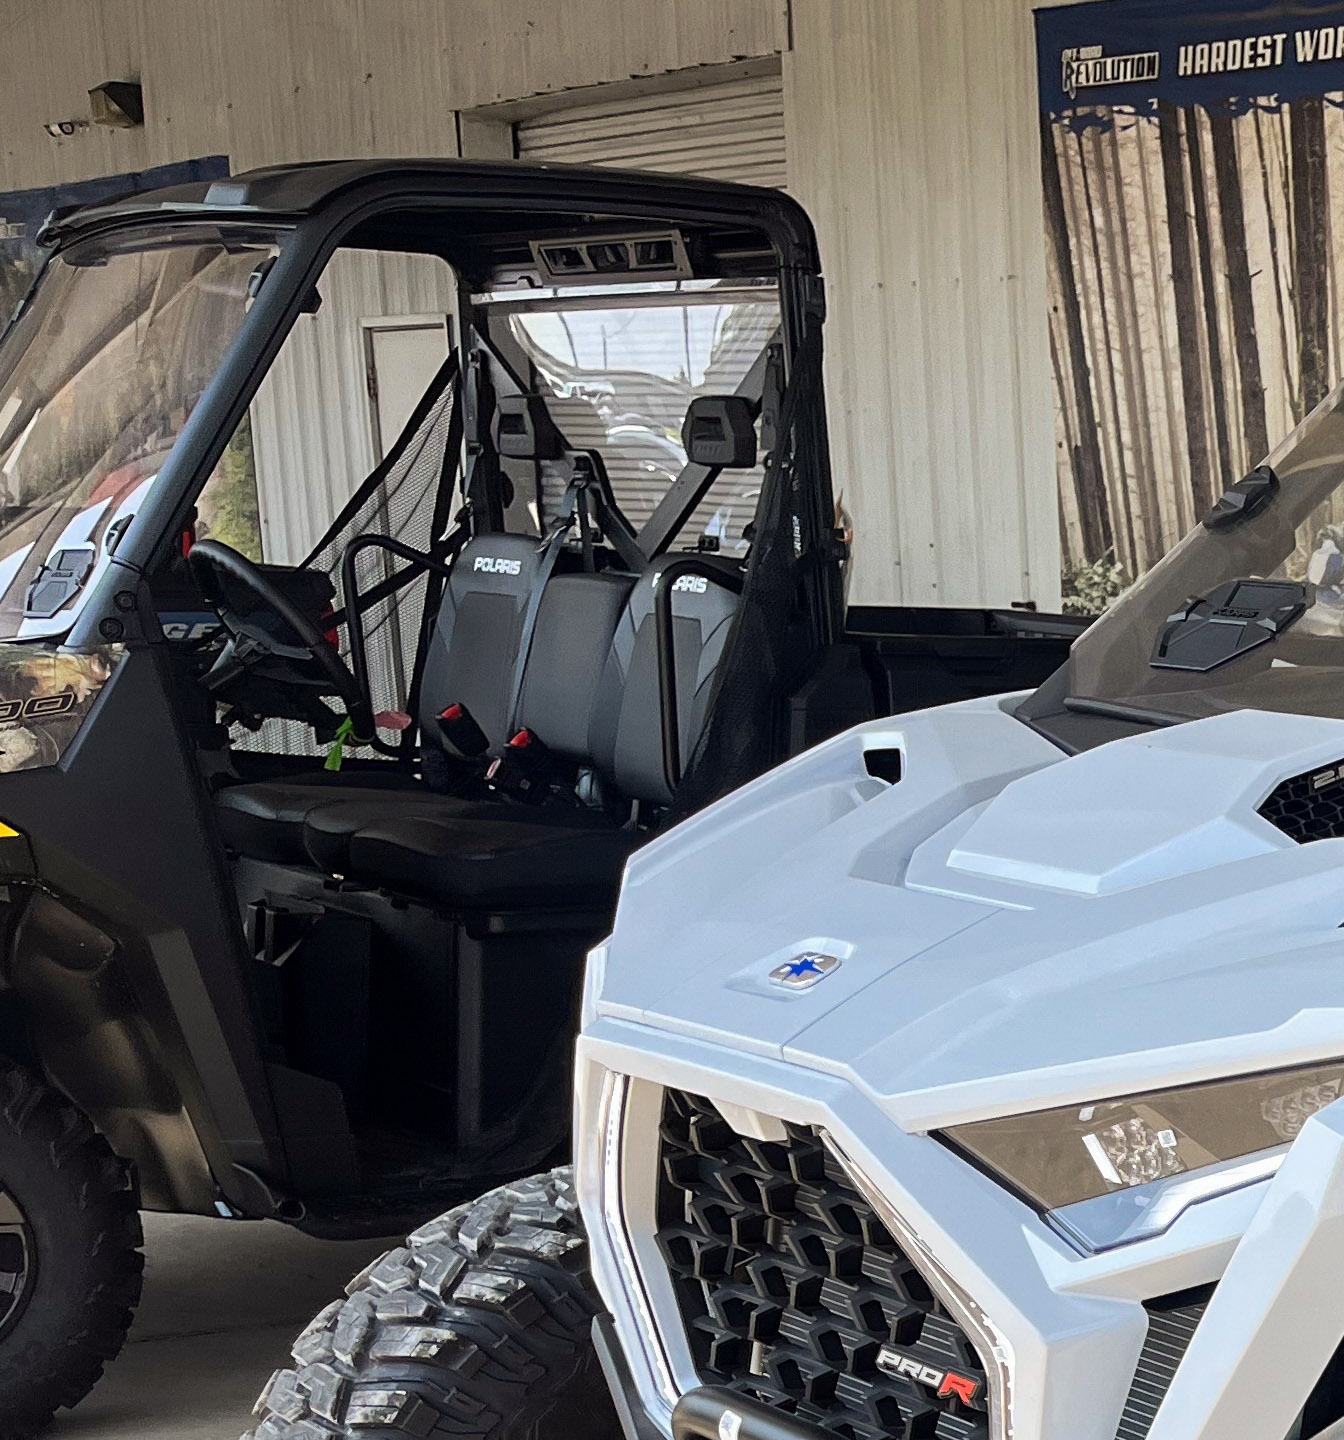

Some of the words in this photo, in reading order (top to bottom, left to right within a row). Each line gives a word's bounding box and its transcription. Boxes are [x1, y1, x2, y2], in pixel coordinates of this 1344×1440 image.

[1178, 33, 1287, 76] HARDEST
[1062, 51, 1160, 98] REVOLUTION
[474, 557, 522, 575] POLARIS
[652, 572, 709, 594] PARIS
